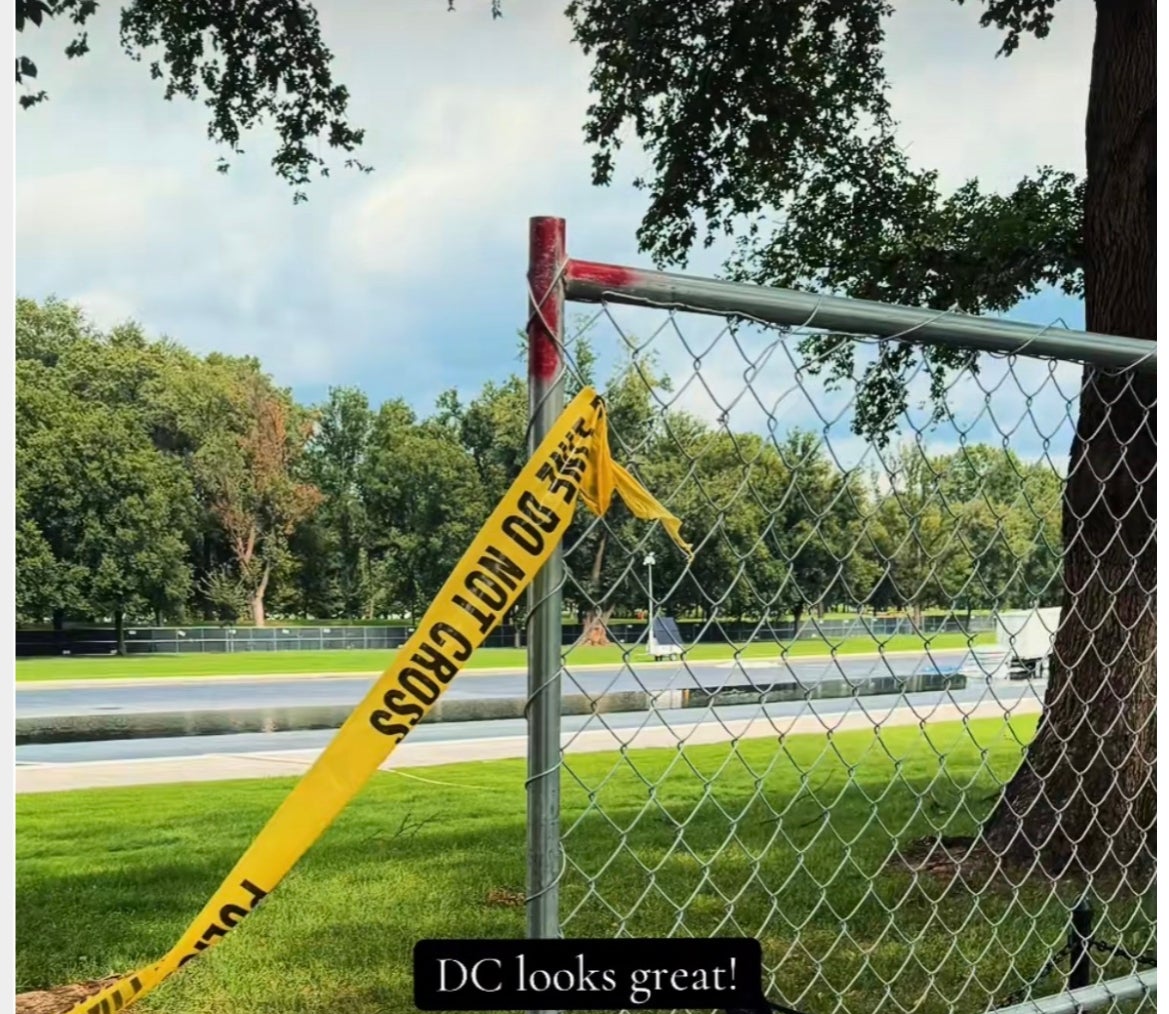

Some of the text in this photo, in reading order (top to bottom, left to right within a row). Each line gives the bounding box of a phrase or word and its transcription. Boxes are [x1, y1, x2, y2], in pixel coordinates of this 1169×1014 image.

[502, 490, 560, 556] DO
[452, 545, 526, 635] NOT
[369, 621, 473, 744] CROSS
